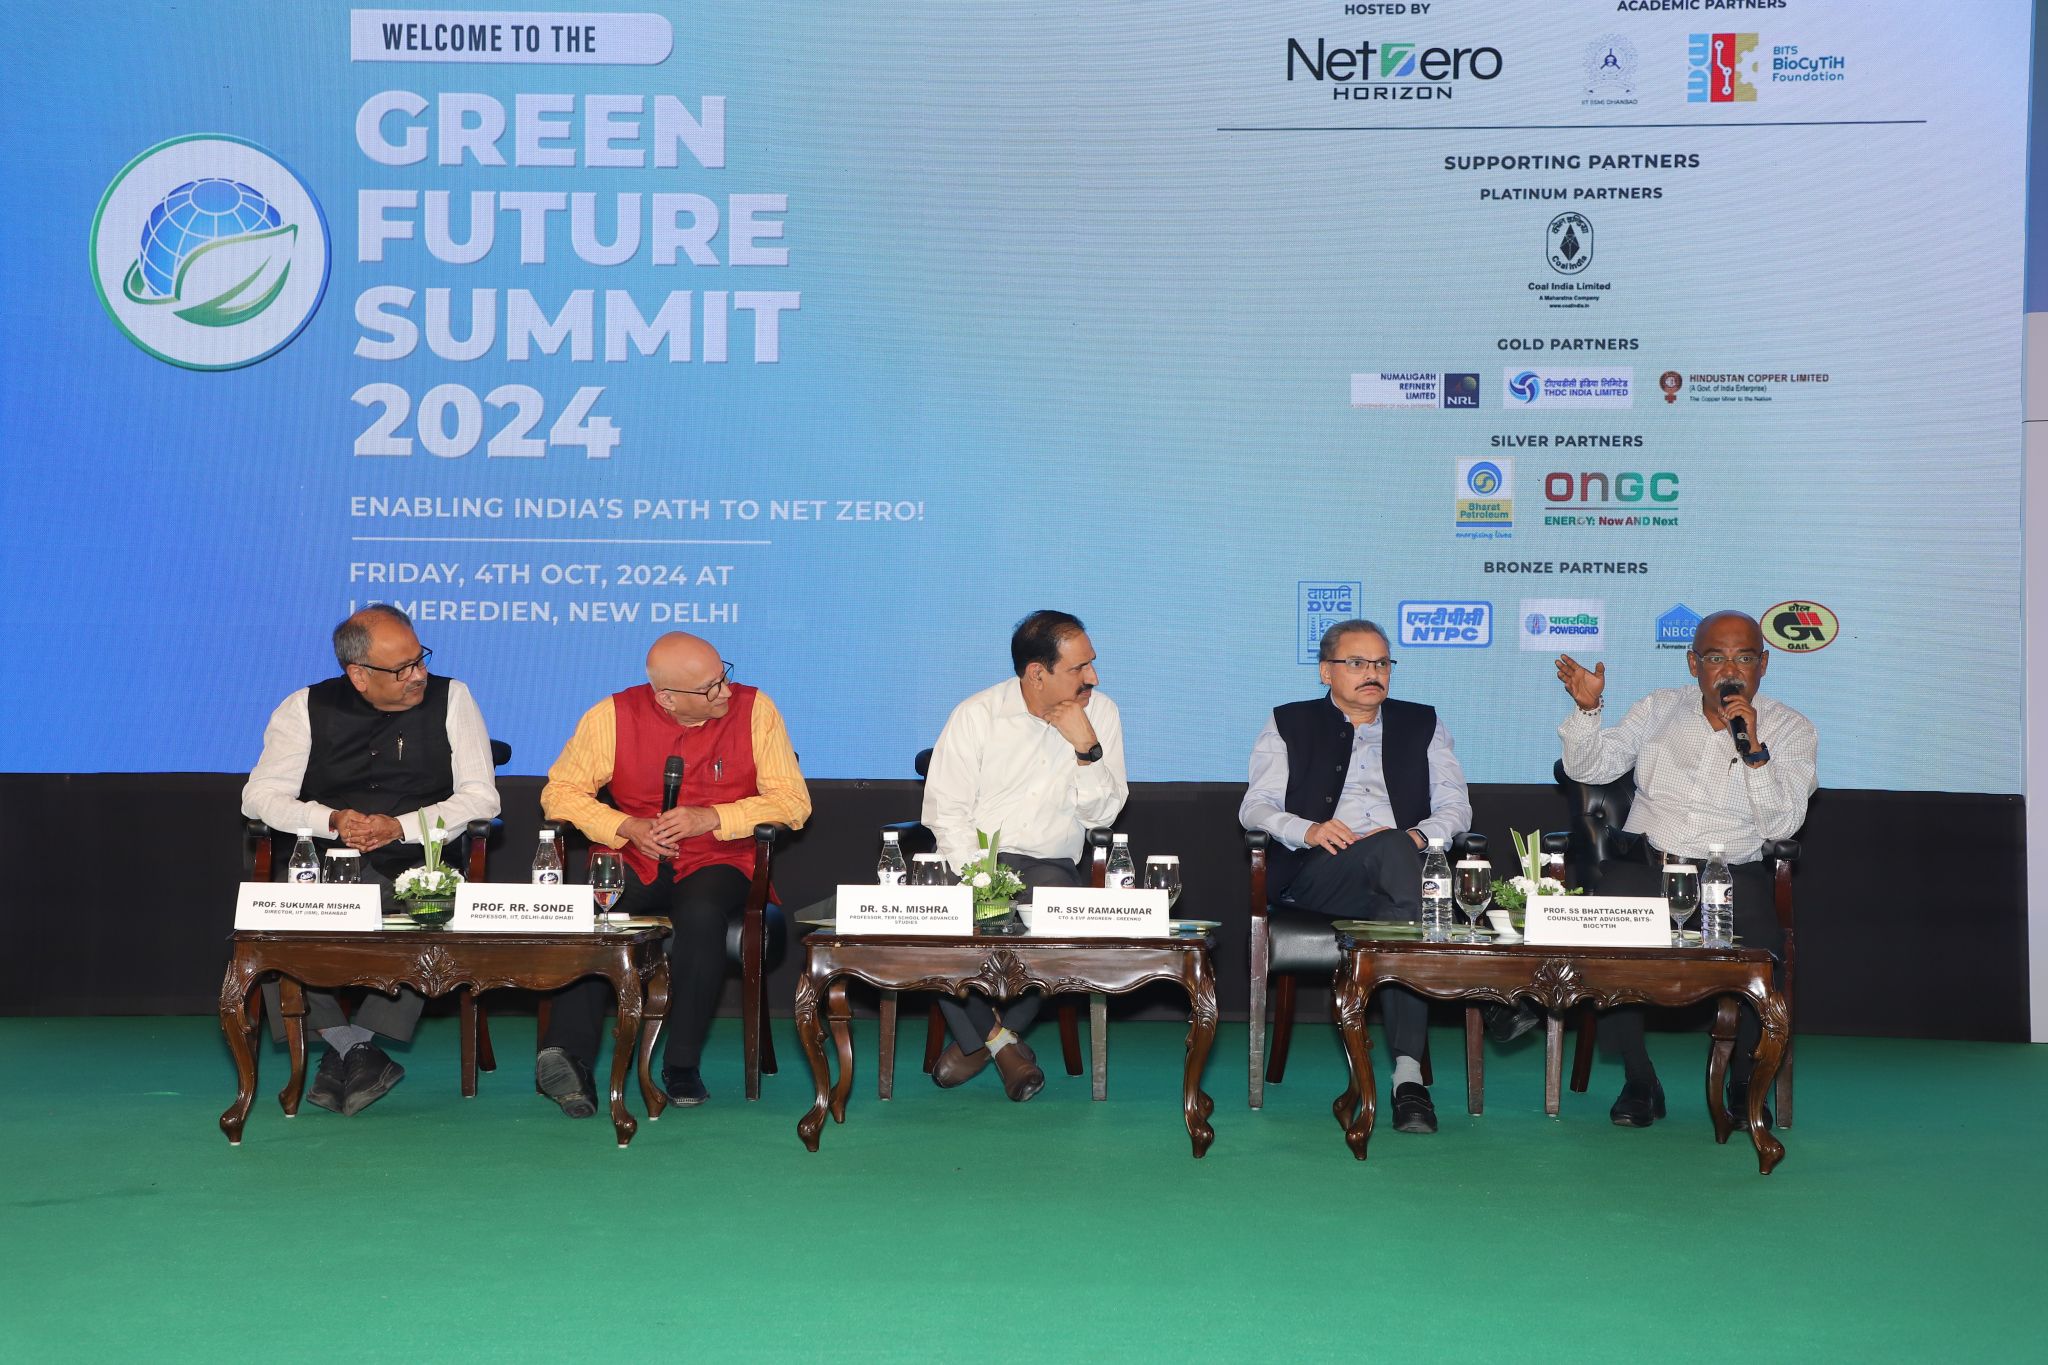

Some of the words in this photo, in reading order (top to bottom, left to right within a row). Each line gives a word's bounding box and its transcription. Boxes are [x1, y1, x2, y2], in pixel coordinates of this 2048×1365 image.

[1344, 3, 1406, 15] HOSTED
[1411, 3, 1431, 15] BY
[1617, 0, 1700, 12] ACADEMIC
[1704, 0, 1787, 10] PARTNERS
[382, 23, 502, 52] WELCOME
[511, 25, 540, 53] TO
[551, 25, 596, 53] THE
[1773, 45, 1799, 55] BITS
[1772, 56, 1845, 73] BioCyTiH
[1772, 72, 1844, 82] Foundation
[1333, 86, 1453, 101] HORIZON
[355, 90, 725, 169] GREEN
[1444, 154, 1582, 170] SUPPORTING
[1588, 153, 1701, 169] PARTNERS
[1480, 187, 1568, 201] PLATINUM
[1573, 186, 1664, 200] PARTNERS
[357, 188, 790, 267] FUTURE
[1551, 255, 1568, 270] Coal
[1569, 255, 1588, 270] India
[1528, 282, 1549, 291] Coal
[1551, 282, 1574, 291] India
[1576, 282, 1611, 291] Limited
[353, 284, 802, 365] SUMMIT
[1497, 338, 1545, 351] GOLD
[1550, 338, 1640, 351] PARTNERS
[1380, 373, 1437, 381] NUMALIGARH
[1689, 374, 1745, 383] HINDUSTAN
[1747, 374, 1788, 383] COPPER
[1790, 373, 1830, 382] LIMITED
[1405, 392, 1436, 400] LIMITED
[1544, 389, 1567, 397] THDC
[1569, 389, 1592, 397] INDIA
[1594, 389, 1629, 397] LIMITED
[1447, 396, 1477, 405] NRL
[350, 382, 622, 460] 2024
[1490, 435, 1549, 448] SILVER
[1554, 435, 1644, 448] PARTNERS
[350, 496, 504, 518] ENABLING
[514, 497, 624, 520] INDIA'S
[633, 499, 710, 520] PATH
[720, 499, 760, 521] TO
[769, 500, 828, 521] NET
[835, 500, 925, 522] ZERO!
[1468, 502, 1501, 511] Bharat
[1460, 510, 1509, 519] Petroleum
[1544, 516, 1596, 526] ENERGY:
[1598, 516, 1624, 526] Now
[1625, 516, 1651, 526] AND
[1652, 516, 1679, 526] Next
[1484, 562, 1553, 574] BRONZE
[1559, 562, 1648, 574] PARTNERS
[350, 562, 465, 588] FRIDAY,
[474, 563, 530, 585] 4TH
[541, 563, 608, 589] OCT,
[616, 564, 688, 586] 2024
[695, 564, 735, 586] AT
[569, 601, 641, 623] NEW
[650, 602, 739, 624] DELHI
[1307, 601, 1352, 612] DVC
[1411, 627, 1478, 641] NTPC
[1549, 626, 1599, 635] POWERGRID
[252, 900, 277, 908] PROF.
[280, 901, 324, 909] SUKUMAR
[326, 902, 361, 910] MISHRA
[472, 902, 505, 912] PROF.
[509, 903, 529, 912] RR.
[533, 903, 574, 913] SONDE
[860, 904, 878, 913] DR.
[881, 905, 903, 913] S.N.
[906, 905, 949, 914] MISHRA
[1047, 906, 1063, 914] DR.
[1066, 906, 1085, 914] SSV
[1088, 907, 1152, 915] RAMAKUMAR
